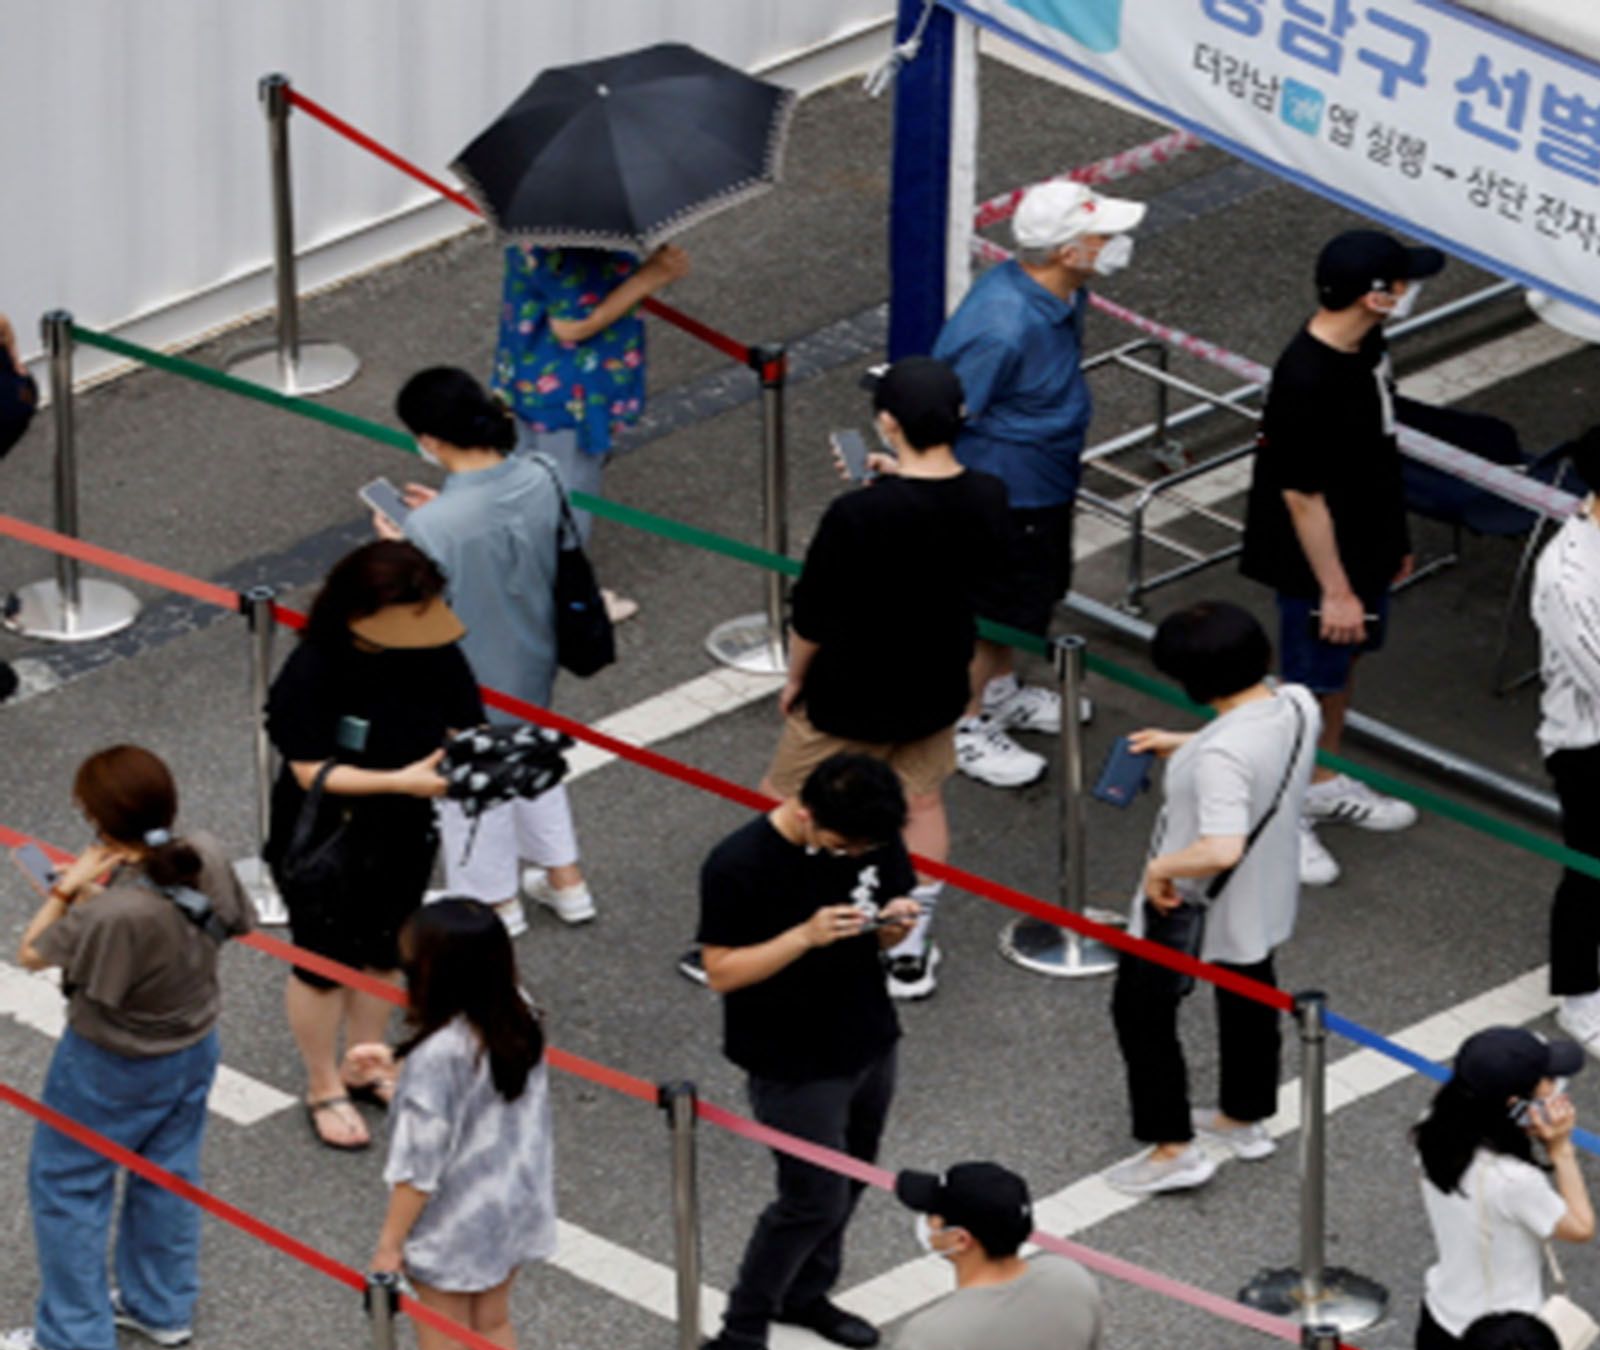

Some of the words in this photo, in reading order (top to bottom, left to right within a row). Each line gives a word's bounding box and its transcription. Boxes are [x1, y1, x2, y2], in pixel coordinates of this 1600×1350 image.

[1194, 42, 1280, 113] 더강남
[1328, 104, 1358, 148] 앱
[1365, 121, 1428, 178] 실행
[1465, 169, 1528, 224] 상단
